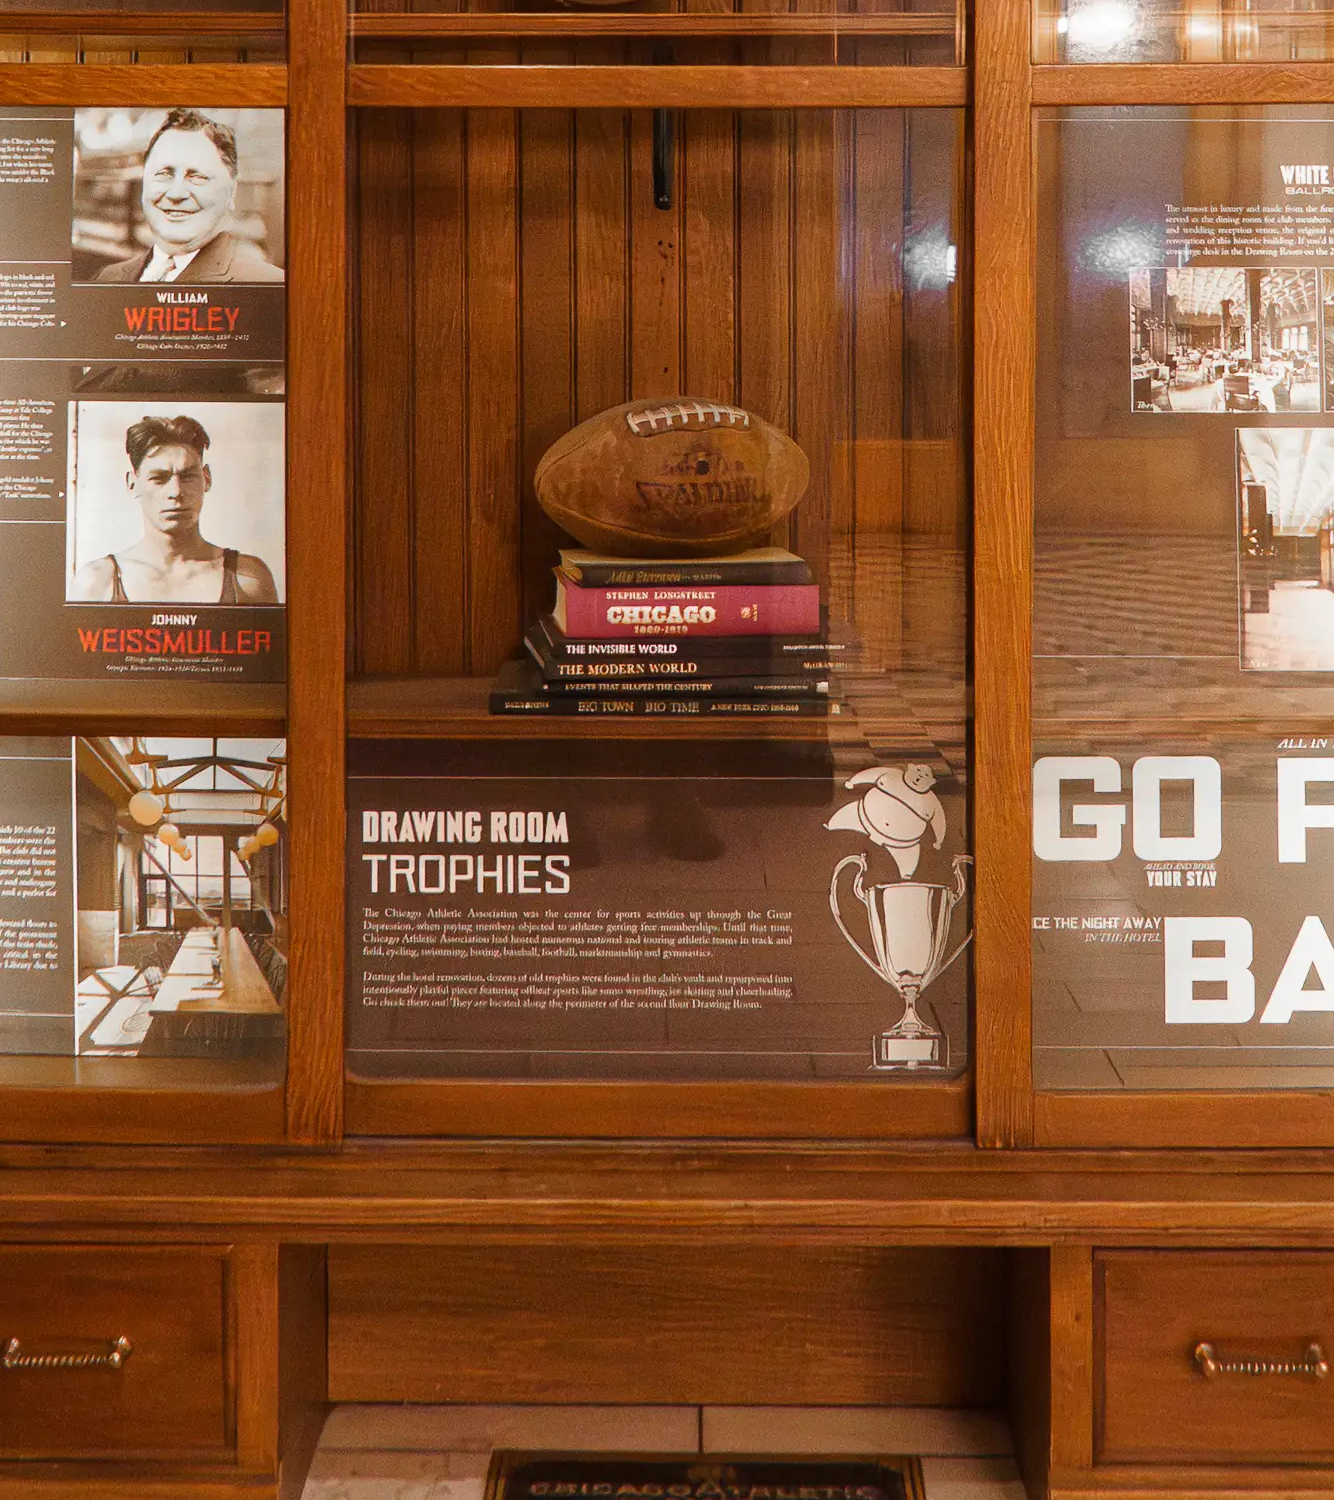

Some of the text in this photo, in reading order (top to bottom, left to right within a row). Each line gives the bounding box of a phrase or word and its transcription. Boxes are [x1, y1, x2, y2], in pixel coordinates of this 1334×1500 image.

[1280, 165, 1330, 185] WHITE
[156, 292, 209, 304] WILLIAM
[124, 307, 240, 332] WRIGLEY
[605, 591, 717, 600] STEPHEN LONGSTREET
[151, 613, 198, 626] JOHNNY
[606, 605, 717, 625] CHICAGO
[77, 627, 272, 655] WEISSMULLER
[566, 644, 678, 654] THE INVISIBLE WORLD
[557, 662, 698, 675] THE MODERN WORLD
[565, 683, 713, 691] EVENTS THAT SHAPED THE CENTURY
[578, 701, 634, 712] BIG TOWN
[645, 702, 700, 713] BIG TIME
[1277, 738, 1307, 749] ALL
[1310, 738, 1328, 749] IN
[1032, 756, 1222, 861] GO
[362, 811, 569, 843] DRAWING ROOM
[362, 854, 570, 894] TROPHIES
[1146, 871, 1217, 888] YOUR STAY
[362, 908, 379, 918] The
[384, 908, 422, 920] Chicago
[427, 908, 462, 918] Athletic
[467, 908, 518, 918] Association
[545, 908, 560, 918] the
[564, 908, 592, 918] center
[596, 908, 610, 918] for
[615, 908, 641, 920] sports
[646, 908, 685, 918] activities
[689, 912, 702, 920] up
[707, 908, 742, 920] through
[747, 908, 762, 918] the
[767, 908, 792, 918] Great
[363, 922, 414, 933] Depression,
[416, 922, 440, 930] when
[444, 922, 472, 933] paying
[475, 922, 515, 930] members
[518, 922, 555, 933] objected
[558, 922, 568, 930] to
[569, 922, 603, 930] athletes
[606, 922, 637, 933] getting
[749, 922, 767, 930] that
[1054, 917, 1078, 930] THE
[1082, 917, 1121, 930] NIGHT
[1124, 917, 1162, 930] AWAY
[363, 934, 400, 946] Chicago
[401, 934, 437, 943] Athletic
[440, 934, 490, 943] Association
[492, 934, 508, 943] had
[510, 934, 540, 943] hosted
[587, 934, 622, 943] national
[625, 934, 641, 943] and
[643, 934, 676, 946] touring
[677, 934, 710, 943] athletic
[739, 934, 749, 943] in
[751, 934, 773, 943] track
[776, 934, 792, 943] and
[1085, 933, 1162, 942] IN THE HOTEL
